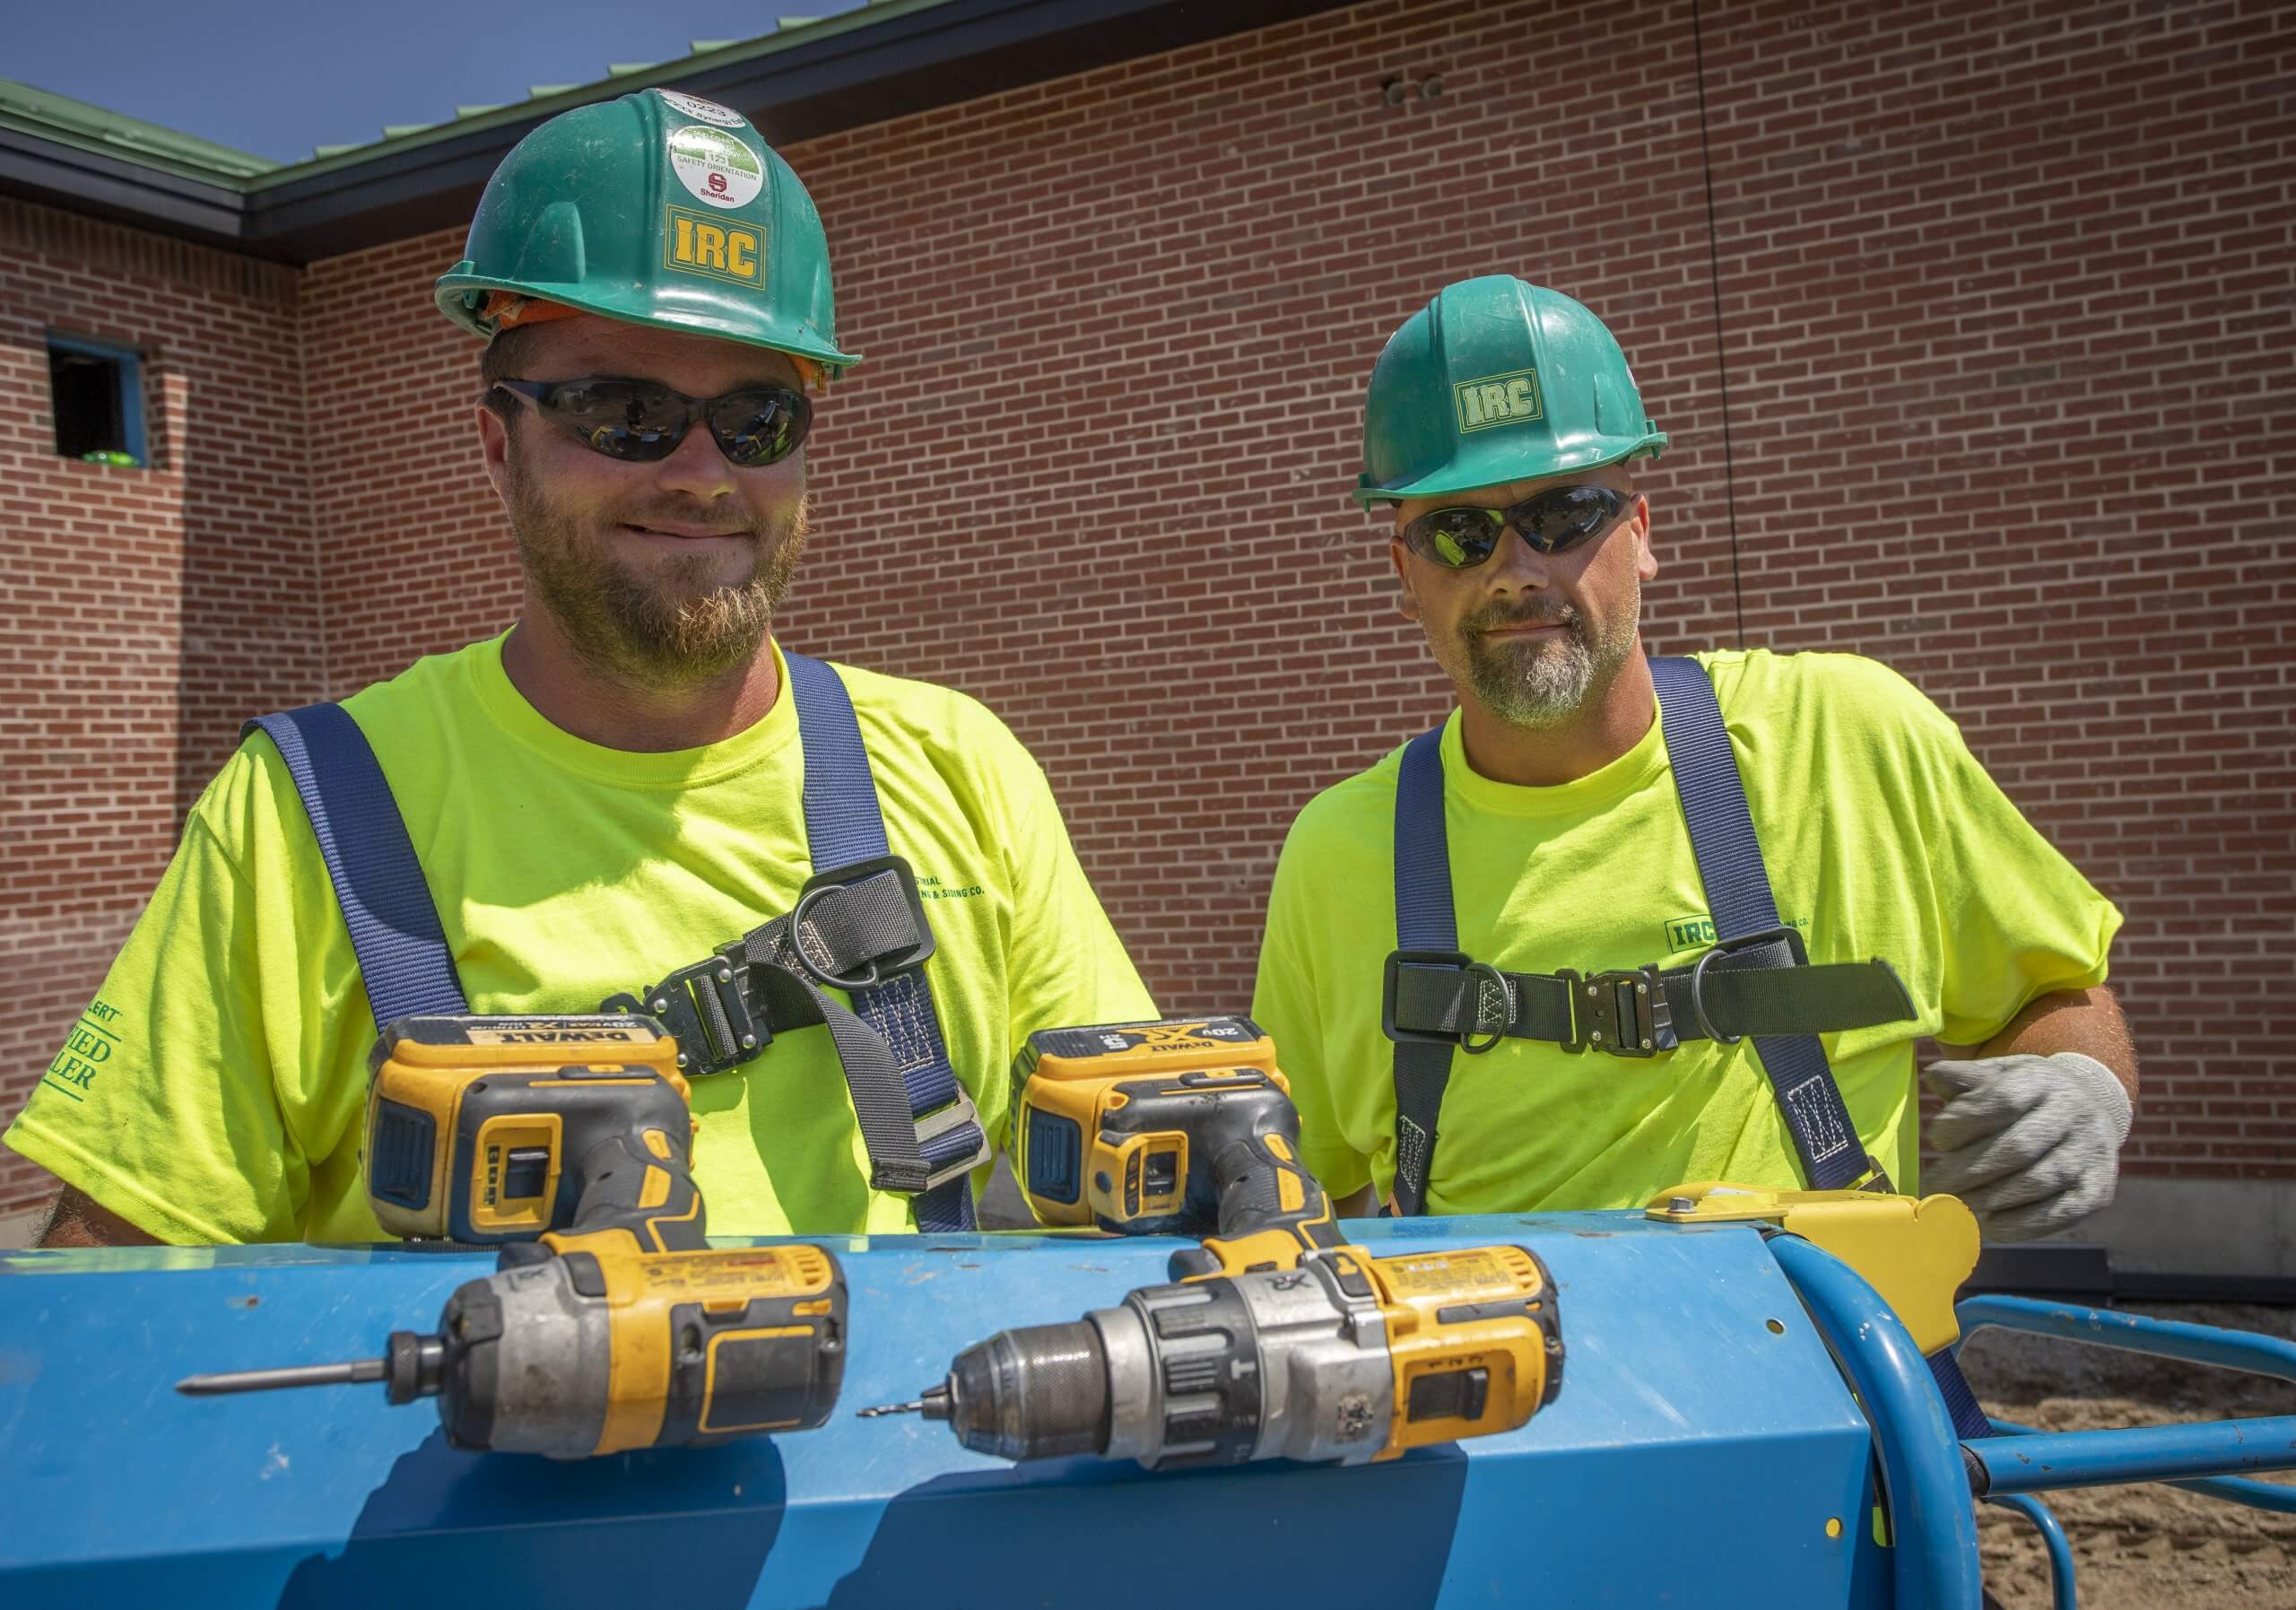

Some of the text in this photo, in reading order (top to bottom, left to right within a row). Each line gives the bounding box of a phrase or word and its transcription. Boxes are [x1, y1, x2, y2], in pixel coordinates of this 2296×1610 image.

[677, 155, 705, 169] SAFETY
[707, 162, 757, 181] ORIENTATION
[700, 187, 735, 203] Sheridan
[674, 215, 757, 279] IRC
[1462, 378, 1534, 426] IRC
[970, 885, 986, 896] CO.
[1674, 920, 1715, 946] IRC
[1103, 1037, 1128, 1049] 5
